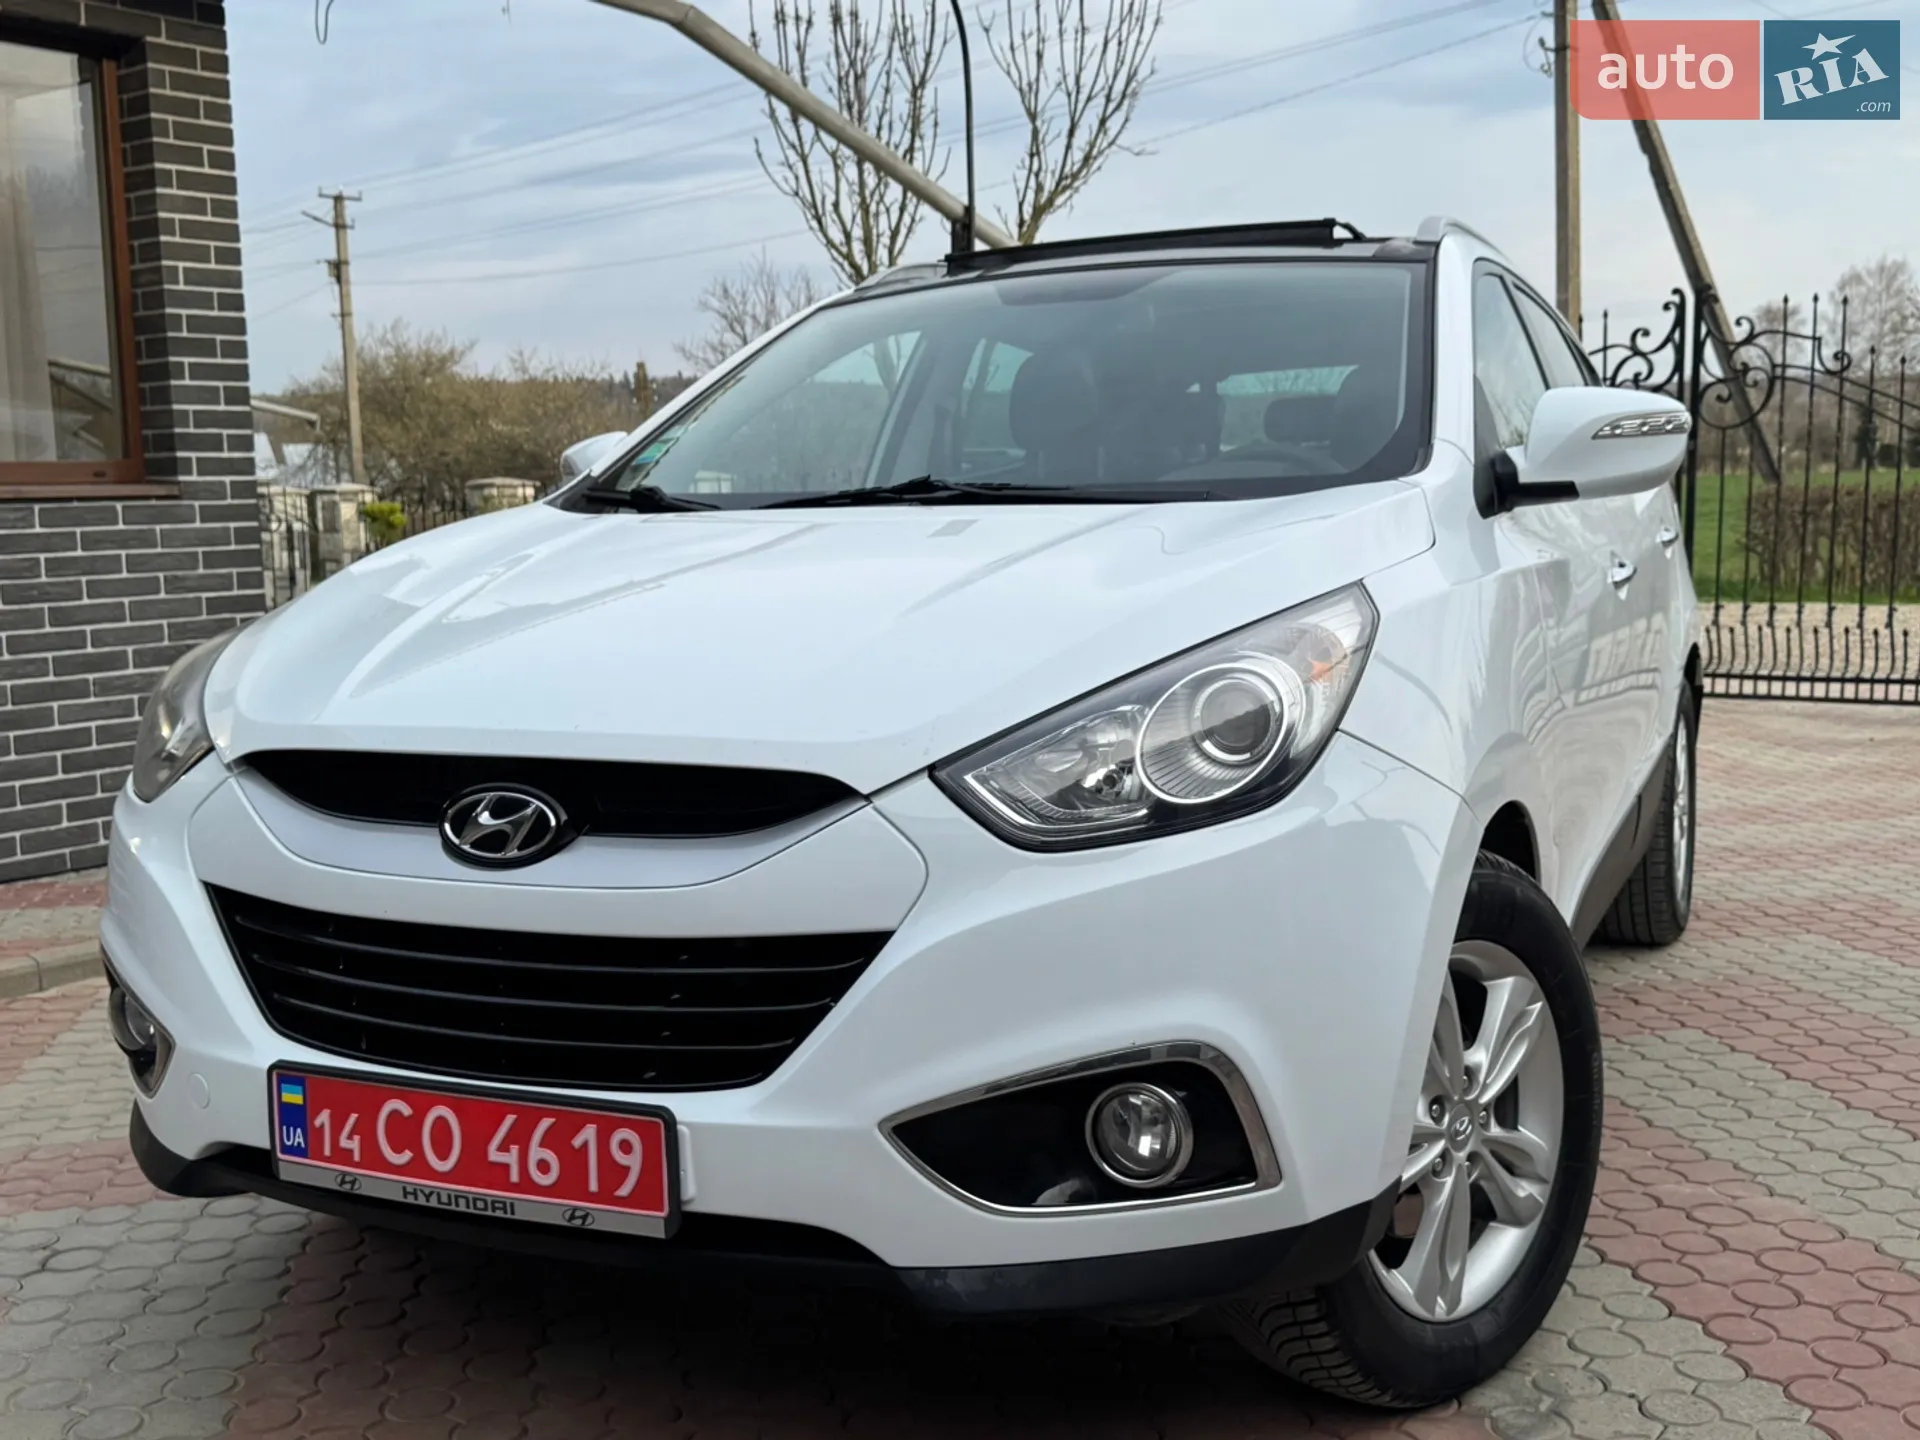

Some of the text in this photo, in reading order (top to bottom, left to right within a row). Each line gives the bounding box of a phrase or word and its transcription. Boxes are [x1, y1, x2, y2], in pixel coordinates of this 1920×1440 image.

[282, 1125, 305, 1149] UA
[313, 1098, 644, 1198] 14 CO 4619
[401, 1185, 516, 1216] HYUNDAI
